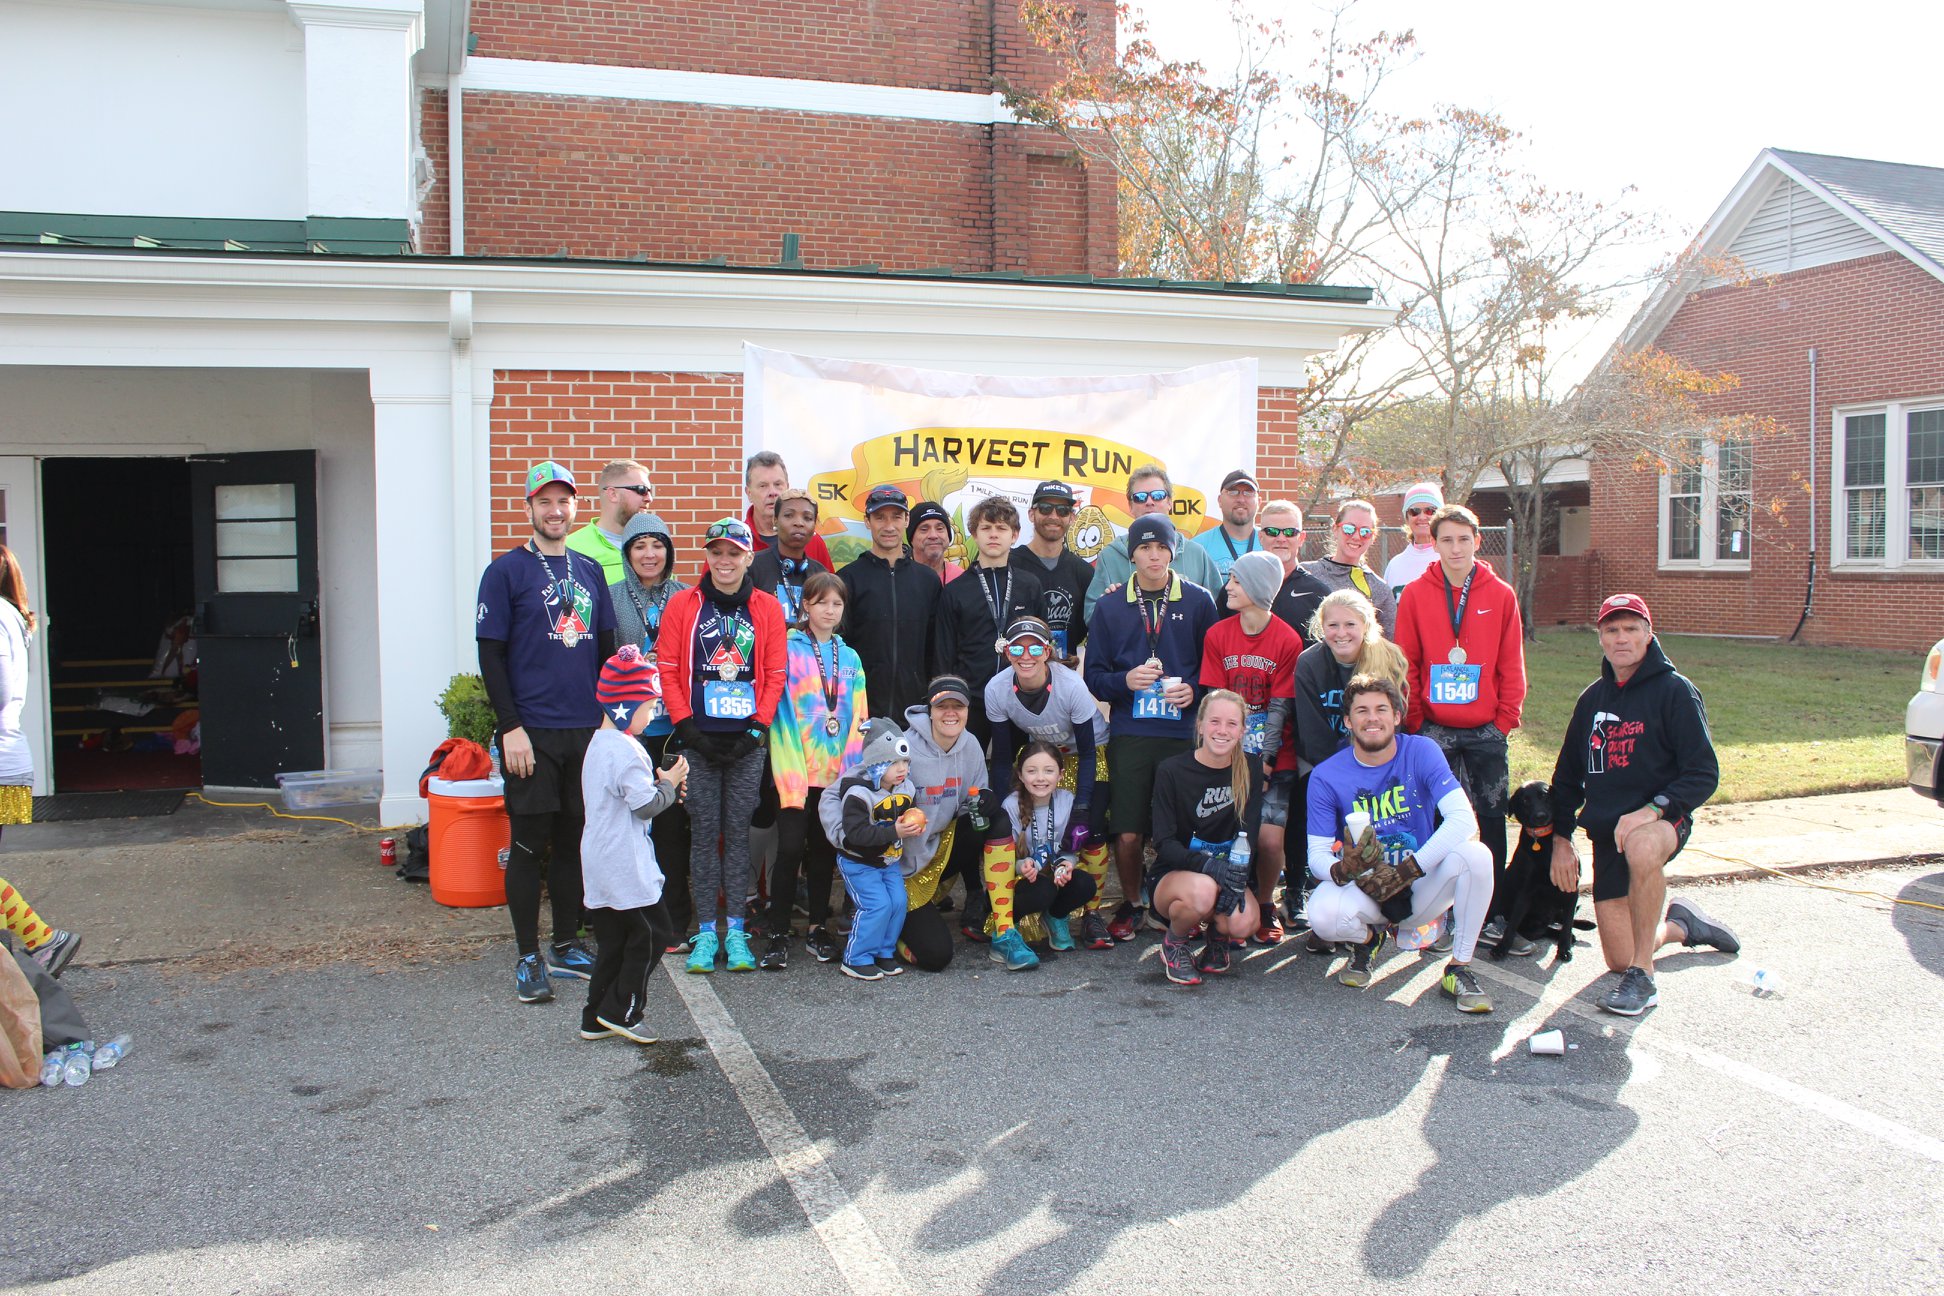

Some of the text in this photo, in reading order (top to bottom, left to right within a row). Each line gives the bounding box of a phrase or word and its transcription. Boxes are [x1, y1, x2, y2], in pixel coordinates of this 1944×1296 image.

[893, 433, 1132, 477] HARVEST RUN
[817, 482, 848, 501] 5K
[976, 486, 993, 496] MILE
[1012, 495, 1029, 505] RUN
[1240, 654, 1277, 674] COUNTY
[1434, 682, 1477, 701] 1540
[708, 696, 753, 717] 1355
[1137, 697, 1179, 717] 1414
[1028, 723, 1061, 735] TROT
[1203, 786, 1234, 804] RUN
[1352, 785, 1411, 822] NIKE
